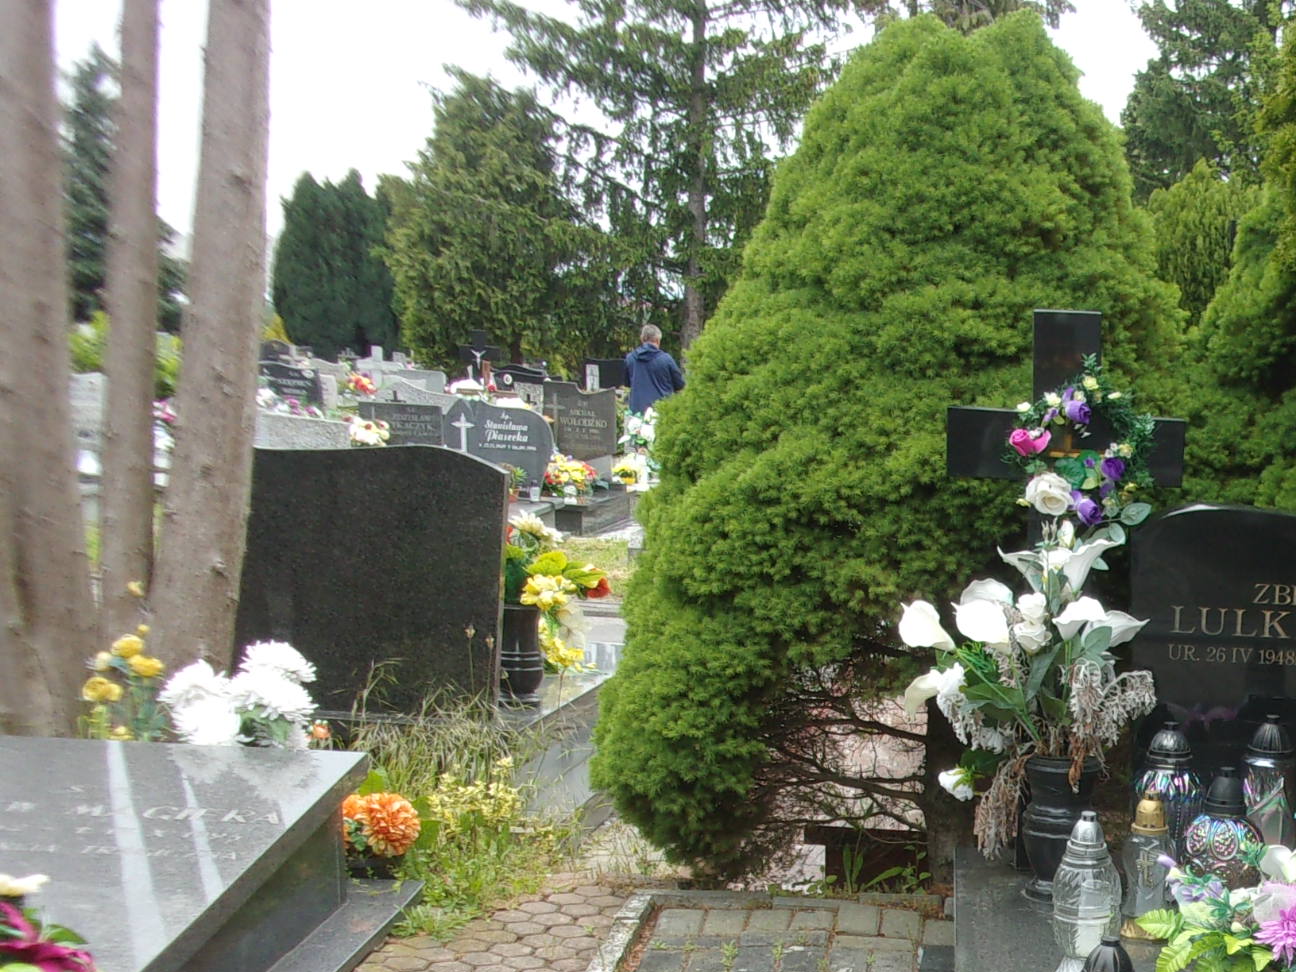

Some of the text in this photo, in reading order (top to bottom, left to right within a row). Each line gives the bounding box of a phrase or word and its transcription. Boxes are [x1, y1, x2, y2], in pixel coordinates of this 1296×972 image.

[1168, 643, 1200, 661] UR.
[1206, 646, 1227, 662] 26
[1231, 647, 1254, 663] IV
